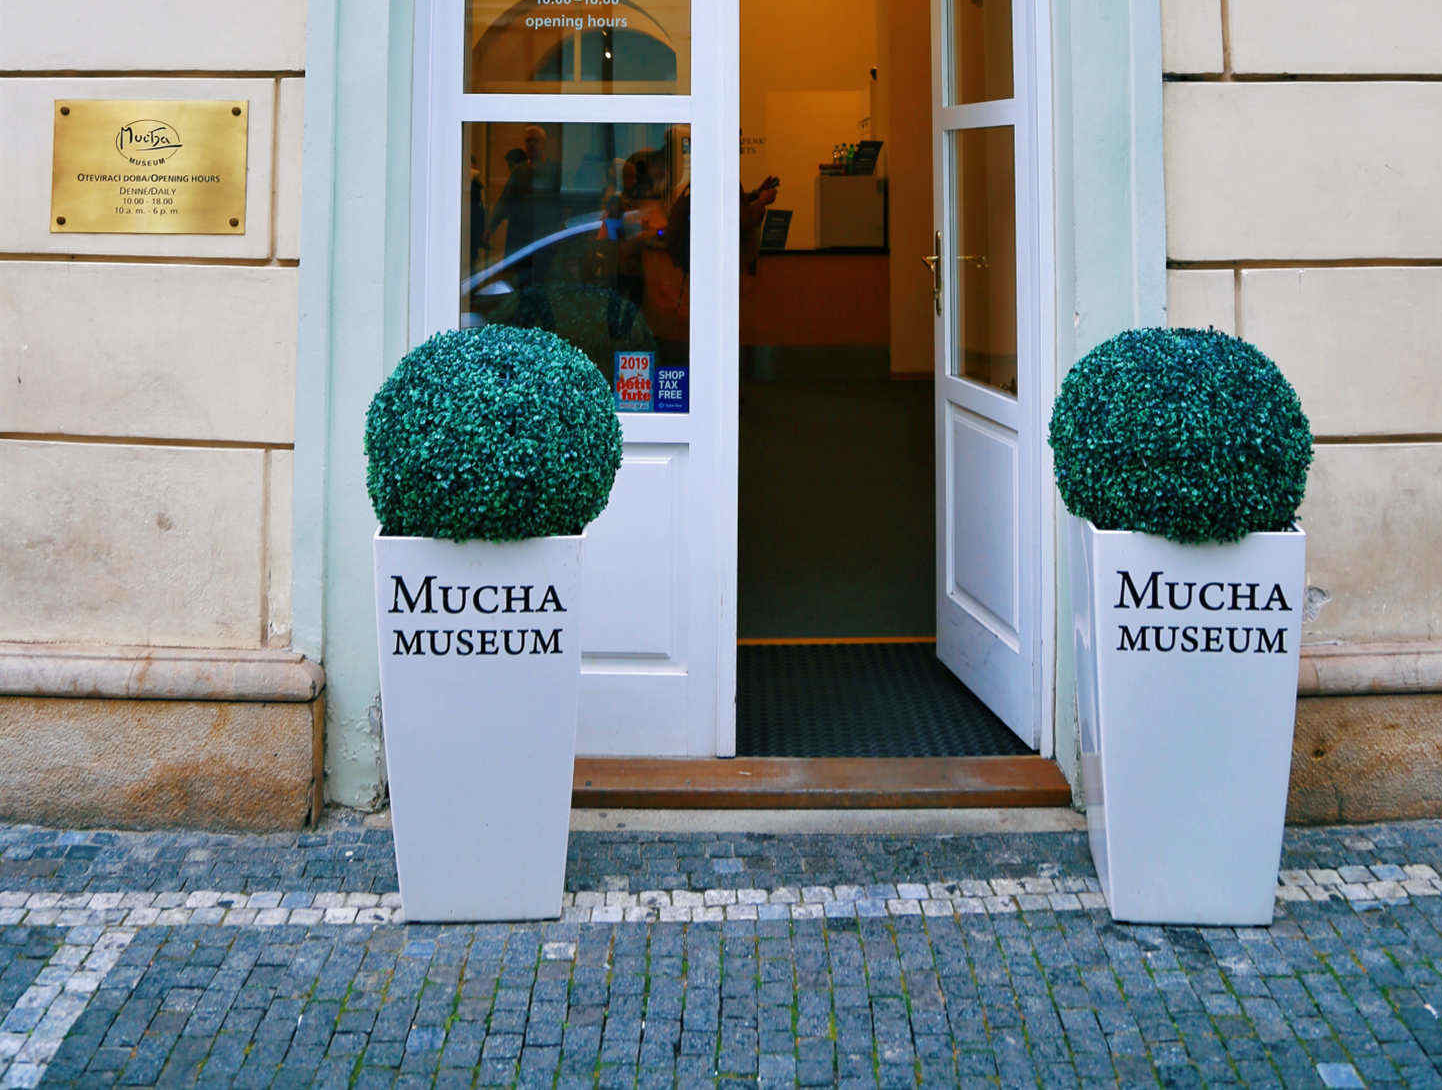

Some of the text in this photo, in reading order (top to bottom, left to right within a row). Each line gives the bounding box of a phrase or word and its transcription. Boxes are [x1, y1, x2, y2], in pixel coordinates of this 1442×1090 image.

[525, 14, 628, 30] opening hours
[120, 126, 171, 150] Mucha
[129, 157, 166, 166] MUSEUM
[192, 174, 220, 183] HOURS
[620, 356, 649, 370] 2019
[658, 370, 685, 380] SHOP
[659, 380, 679, 390] TAX
[658, 390, 683, 399] FREE
[388, 575, 568, 614] MUCHA
[1113, 570, 1293, 611] MUCHA
[392, 628, 564, 656] MUSEUM
[1116, 625, 1288, 654] MUSEUM
